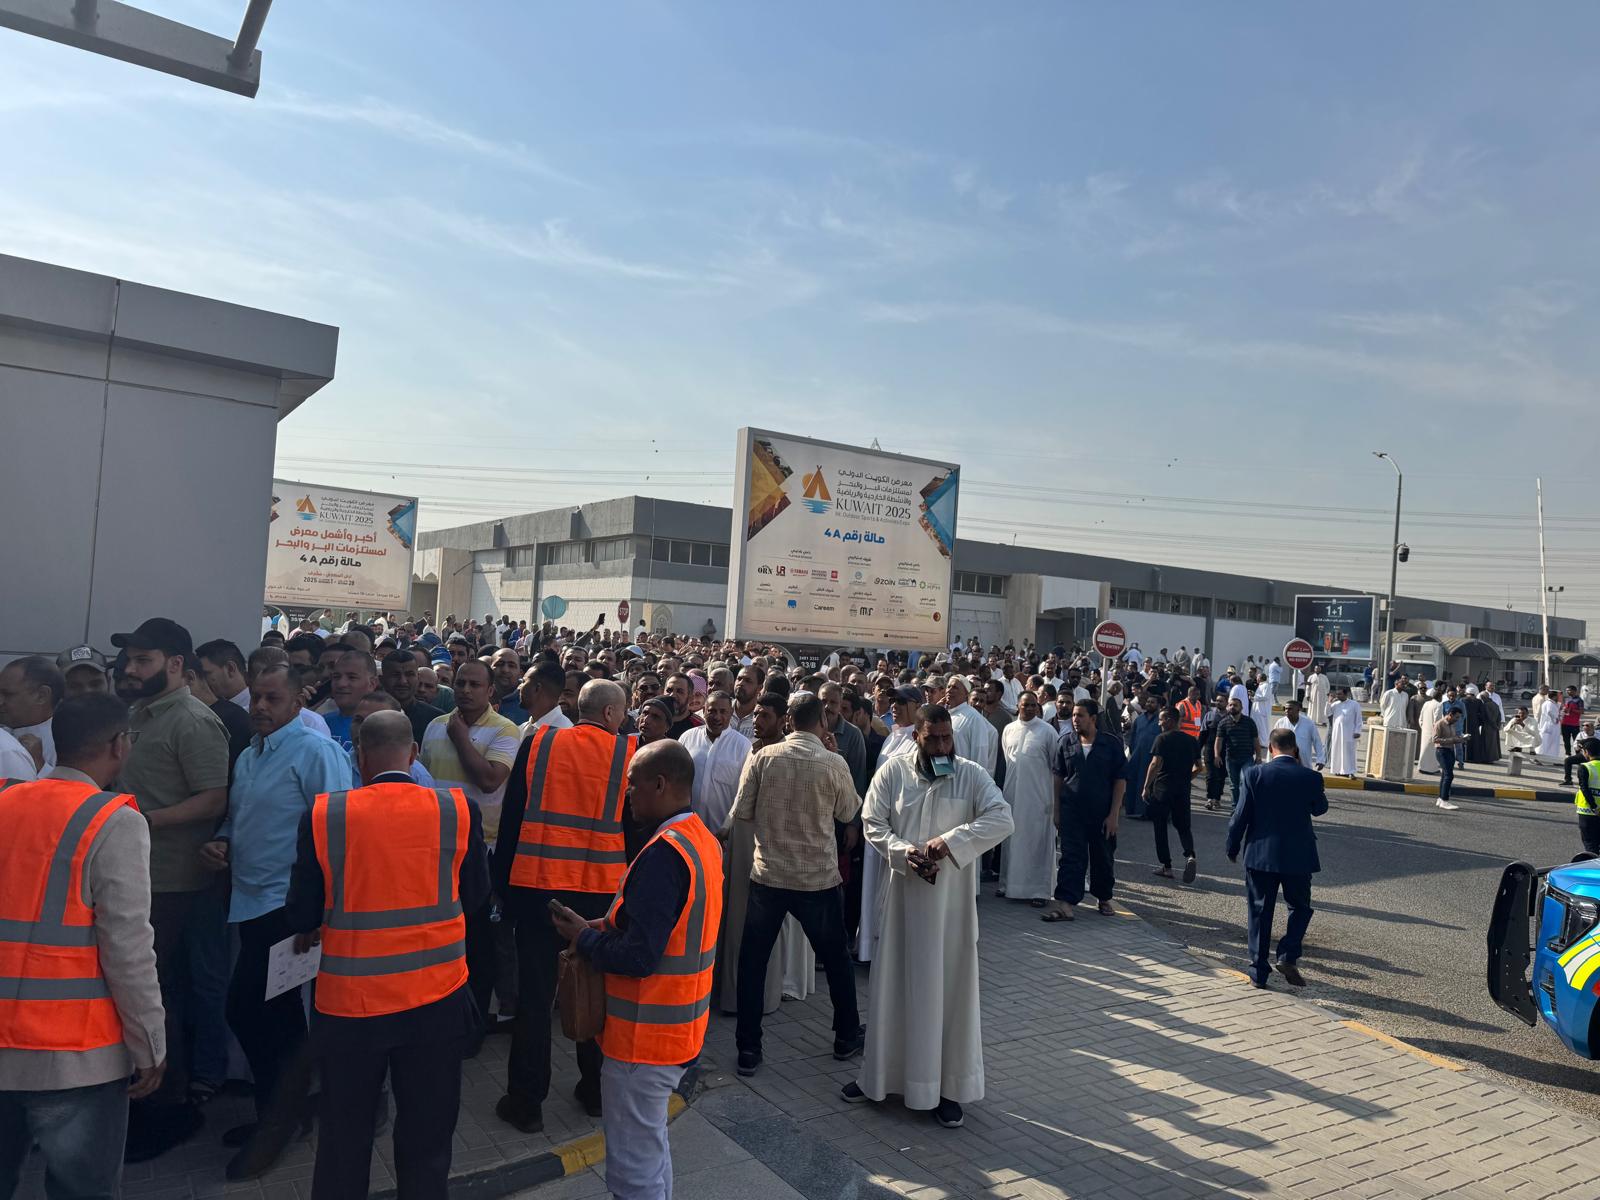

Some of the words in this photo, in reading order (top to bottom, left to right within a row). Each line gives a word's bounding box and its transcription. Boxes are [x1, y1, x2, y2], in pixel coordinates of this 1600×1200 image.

[865, 473, 889, 483] الكويت
[891, 478, 912, 487] معرض
[836, 497, 883, 515] KUWAIT
[885, 505, 911, 519] 2025
[319, 511, 353, 521] KUWAIT
[354, 515, 374, 524] 2025
[290, 526, 318, 537] معرض
[321, 528, 352, 542] وأشمل
[355, 531, 377, 544] أكبر
[843, 530, 862, 543] رقم
[864, 530, 885, 544] صالة
[275, 539, 310, 549] والبحر
[312, 542, 334, 552] البر
[336, 542, 387, 556] لمستلزمات
[319, 555, 338, 567] رقم
[340, 555, 361, 567] صالة
[1325, 605, 1343, 616] 1+1
